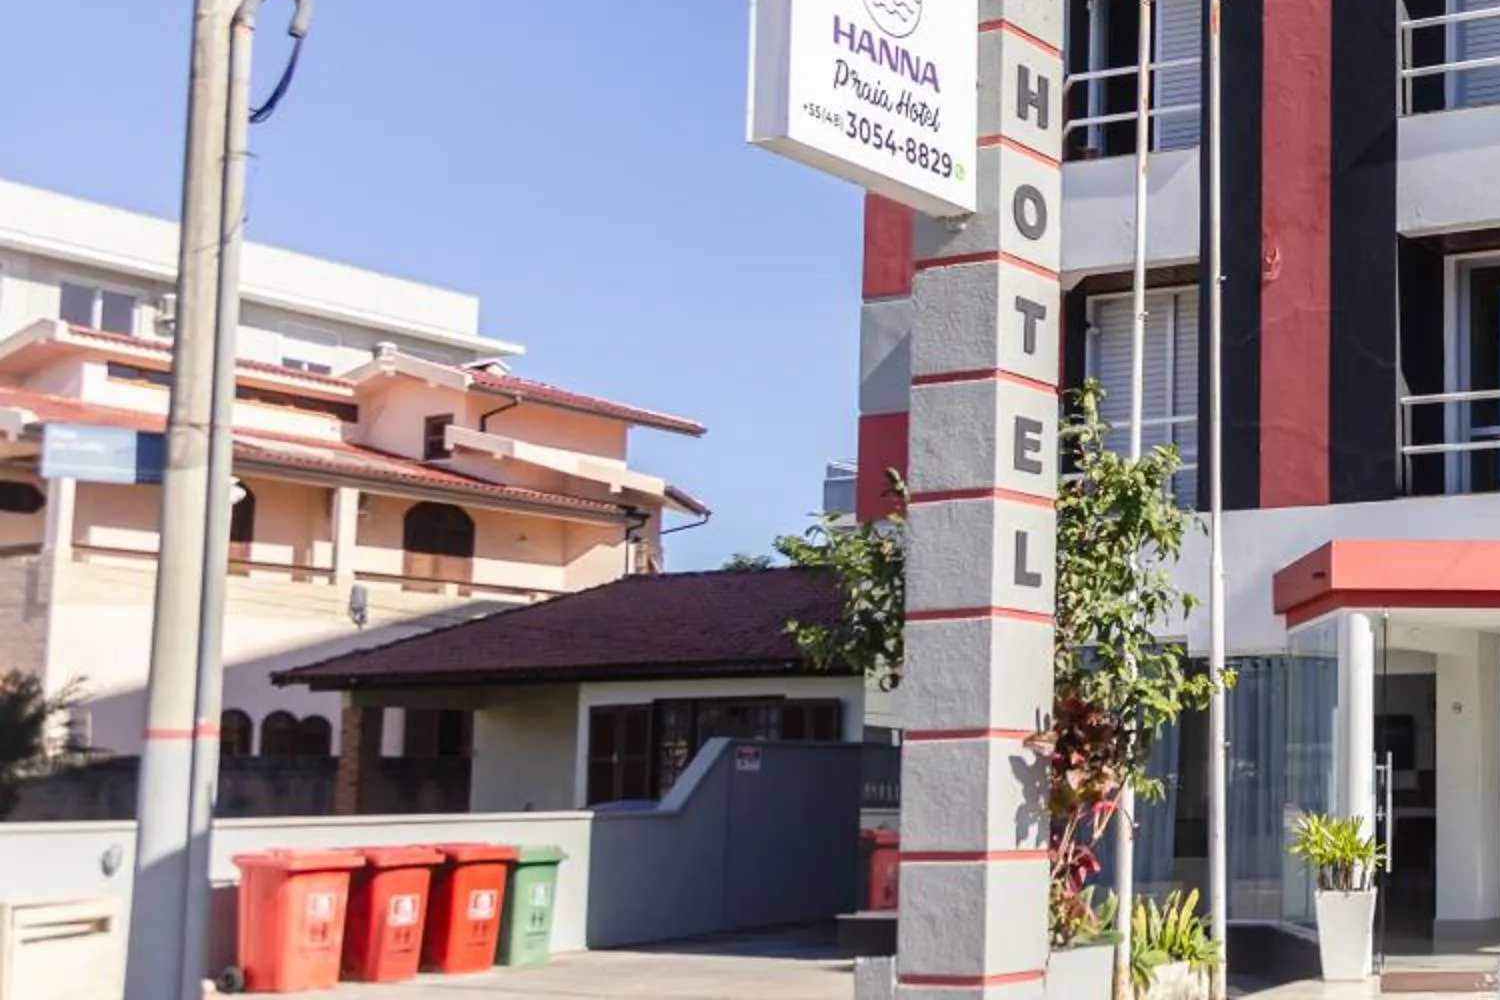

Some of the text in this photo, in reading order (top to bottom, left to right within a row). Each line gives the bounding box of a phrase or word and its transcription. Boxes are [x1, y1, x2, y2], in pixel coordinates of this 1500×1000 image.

[833, 13, 941, 94] HANNA
[833, 58, 941, 133] Praia Hotel
[846, 110, 953, 178] 3054-8829
[1013, 64, 1050, 588] HOTEL
